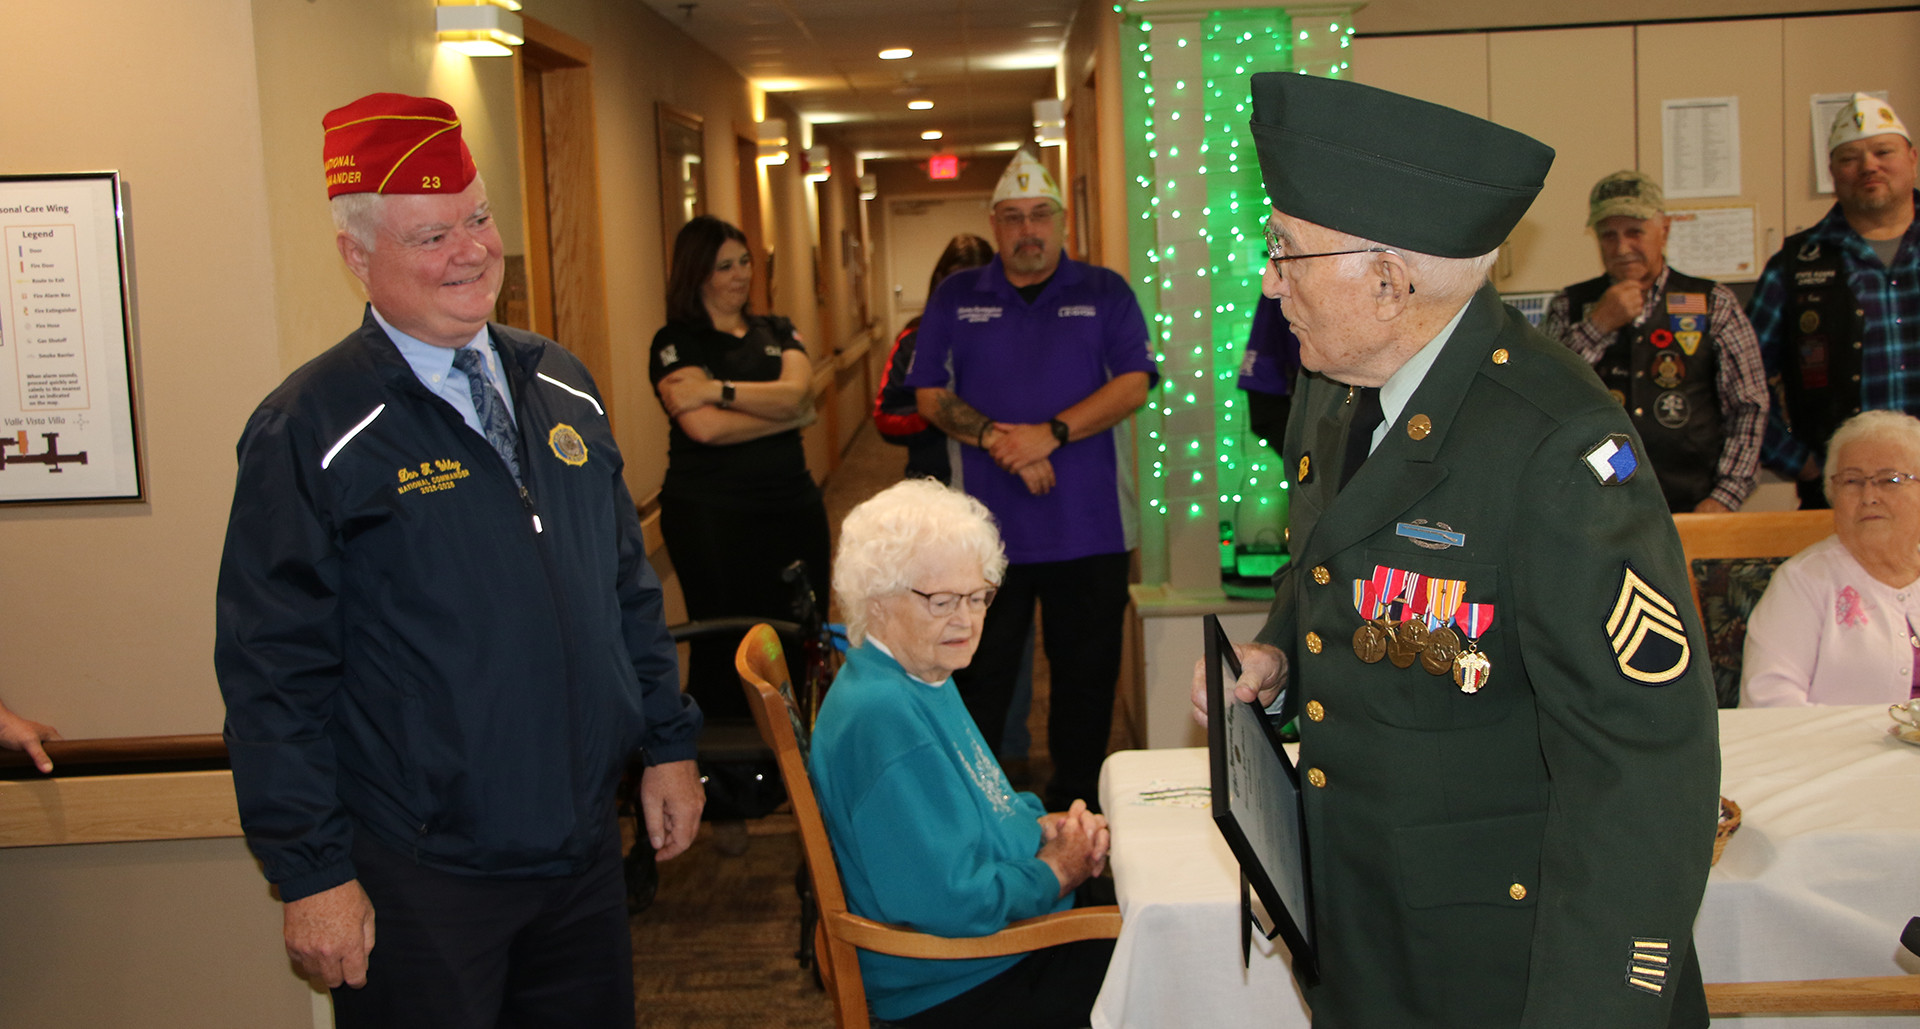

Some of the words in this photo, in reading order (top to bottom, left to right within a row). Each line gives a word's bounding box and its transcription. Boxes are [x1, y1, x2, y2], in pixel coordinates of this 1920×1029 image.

[422, 176, 441, 188] 23
[24, 205, 44, 213] Care
[46, 204, 69, 214] Wing
[22, 229, 54, 240] Legend
[26, 417, 45, 425] Vista
[47, 416, 66, 425] Villa
[397, 479, 431, 495] NATIONAL
[431, 468, 471, 484] COMMANDER
